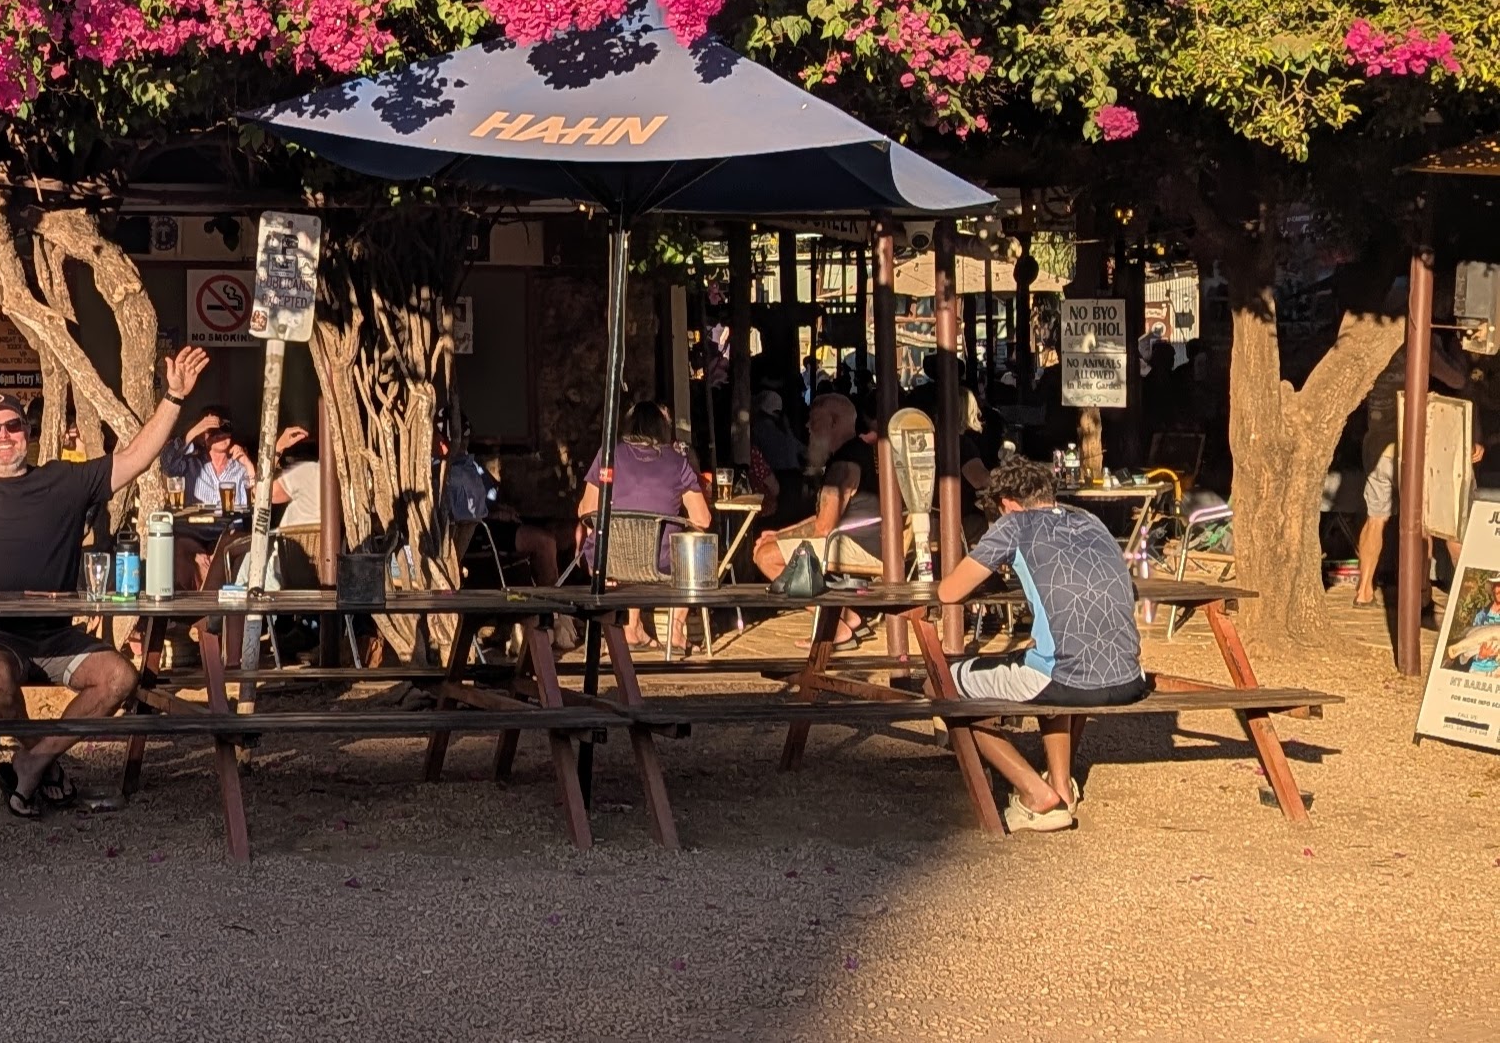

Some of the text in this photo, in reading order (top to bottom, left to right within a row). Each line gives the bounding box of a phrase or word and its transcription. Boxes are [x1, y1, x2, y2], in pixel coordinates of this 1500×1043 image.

[469, 111, 669, 146] HAHN
[1069, 306, 1117, 320] NO BYO
[1064, 322, 1124, 337] ALCOHOL
[191, 333, 206, 342] NO
[1066, 358, 1122, 369] NO ANIMALS
[1073, 370, 1115, 380] ALLOWED
[1077, 380, 1093, 390] Beer
[1095, 381, 1122, 391] Garden
[1463, 679, 1493, 692] BARRA
[1462, 696, 1477, 704] MORE
[1478, 698, 1492, 707] INFO
